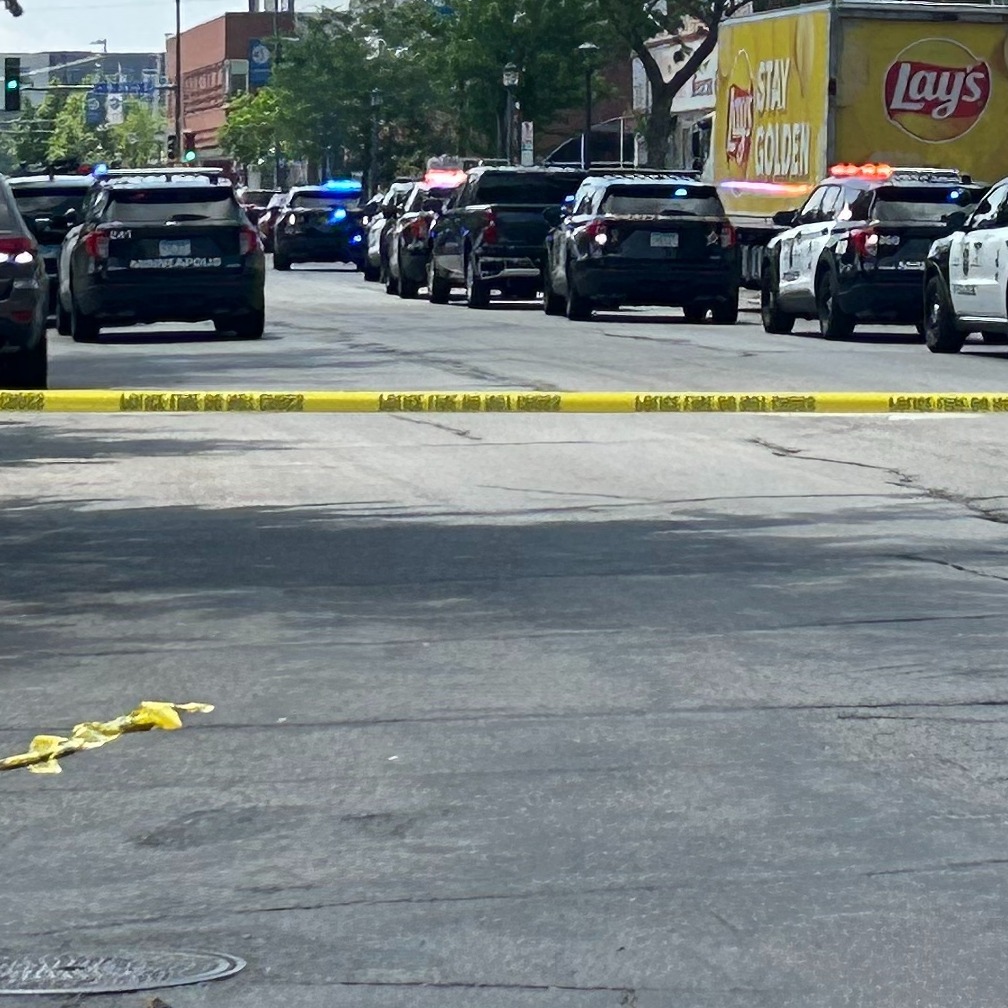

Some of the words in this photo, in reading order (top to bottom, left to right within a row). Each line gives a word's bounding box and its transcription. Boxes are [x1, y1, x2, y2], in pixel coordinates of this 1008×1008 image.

[756, 56, 790, 113] STAY
[890, 61, 985, 120] Lay's
[755, 122, 811, 177] GOLDEN
